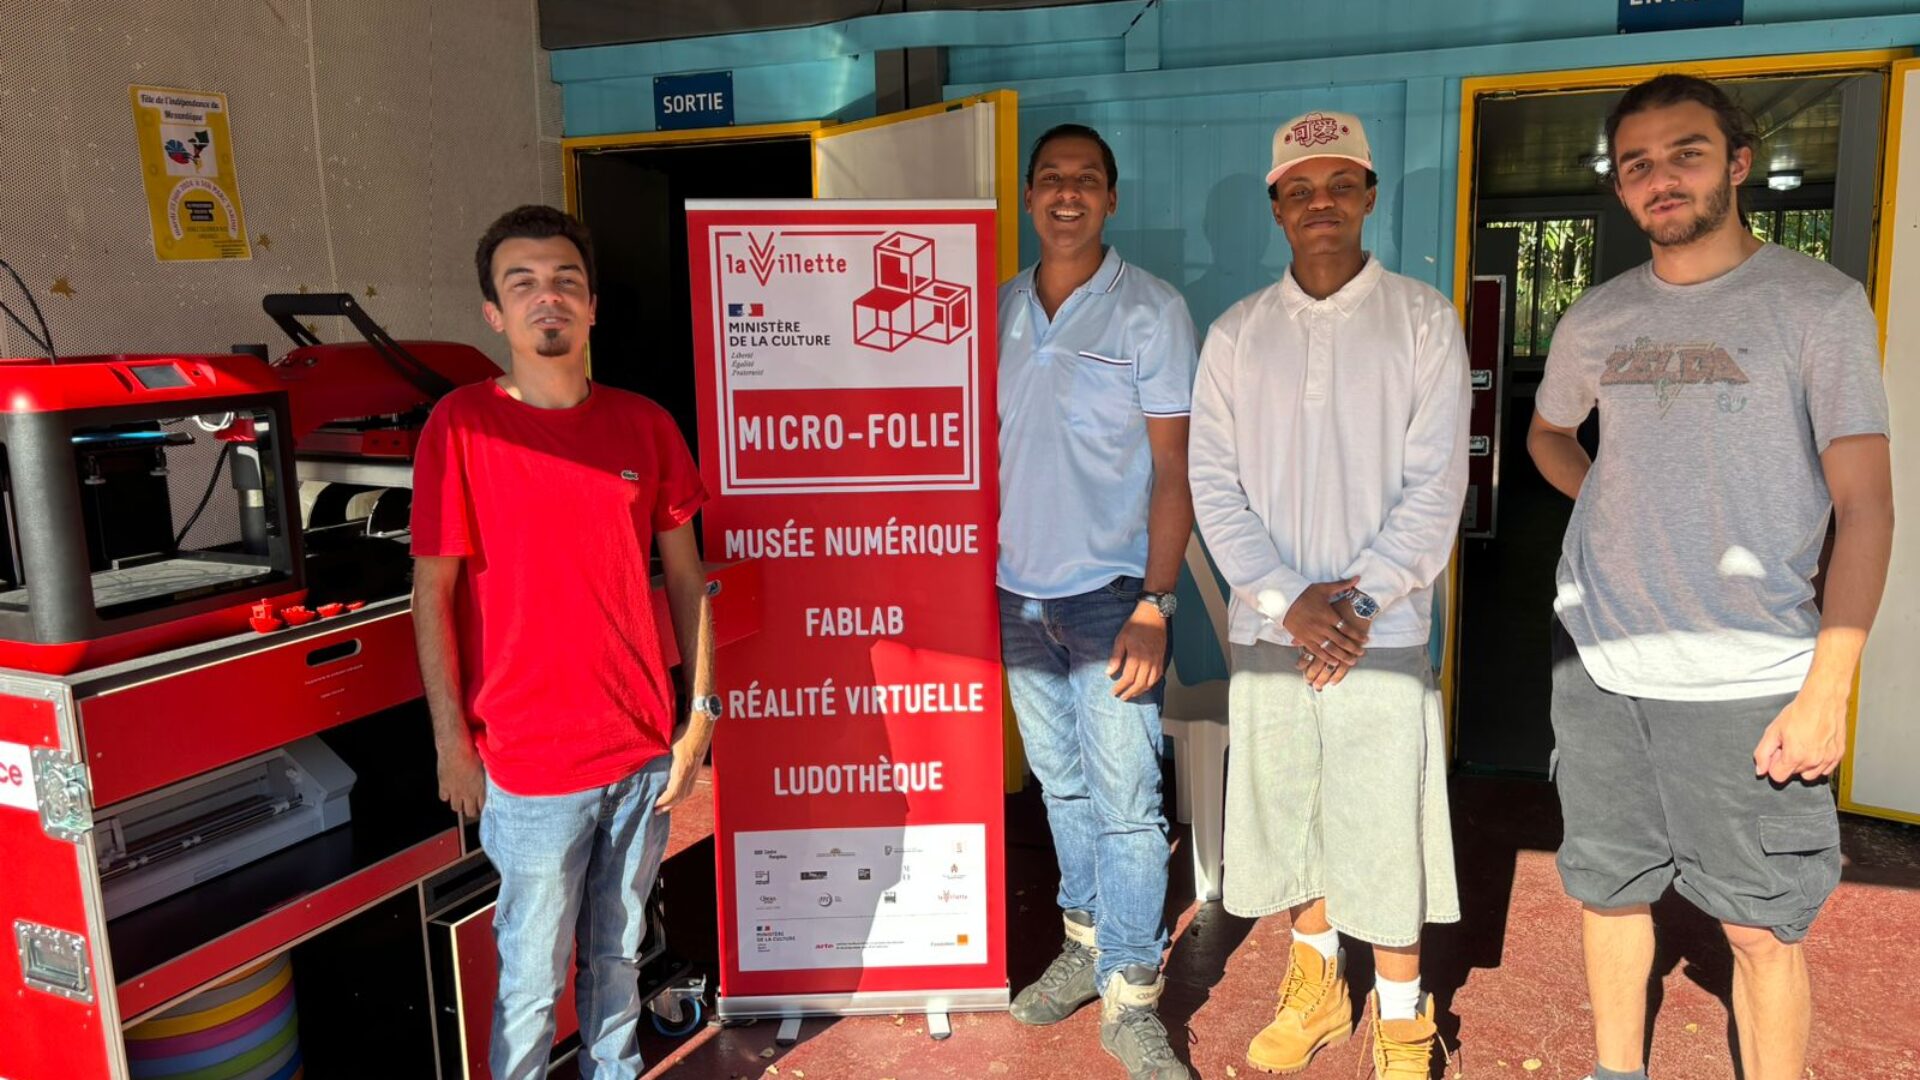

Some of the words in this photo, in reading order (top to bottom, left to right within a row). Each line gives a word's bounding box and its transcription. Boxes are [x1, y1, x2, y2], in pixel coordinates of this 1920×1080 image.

[663, 92, 724, 114] SORTIE
[728, 319, 801, 333] MINISTÈRE
[729, 335, 747, 347] DE
[750, 335, 769, 347] LA
[771, 335, 831, 347] CULTURE
[725, 518, 815, 559] MUSÉE
[825, 516, 979, 557] NUMÉRIQUE
[806, 605, 904, 637] FABLAB
[729, 678, 836, 718] RÉALITÉ
[845, 682, 984, 715] VIRTUELLE
[774, 755, 944, 796] LUDOTHÈQUE
